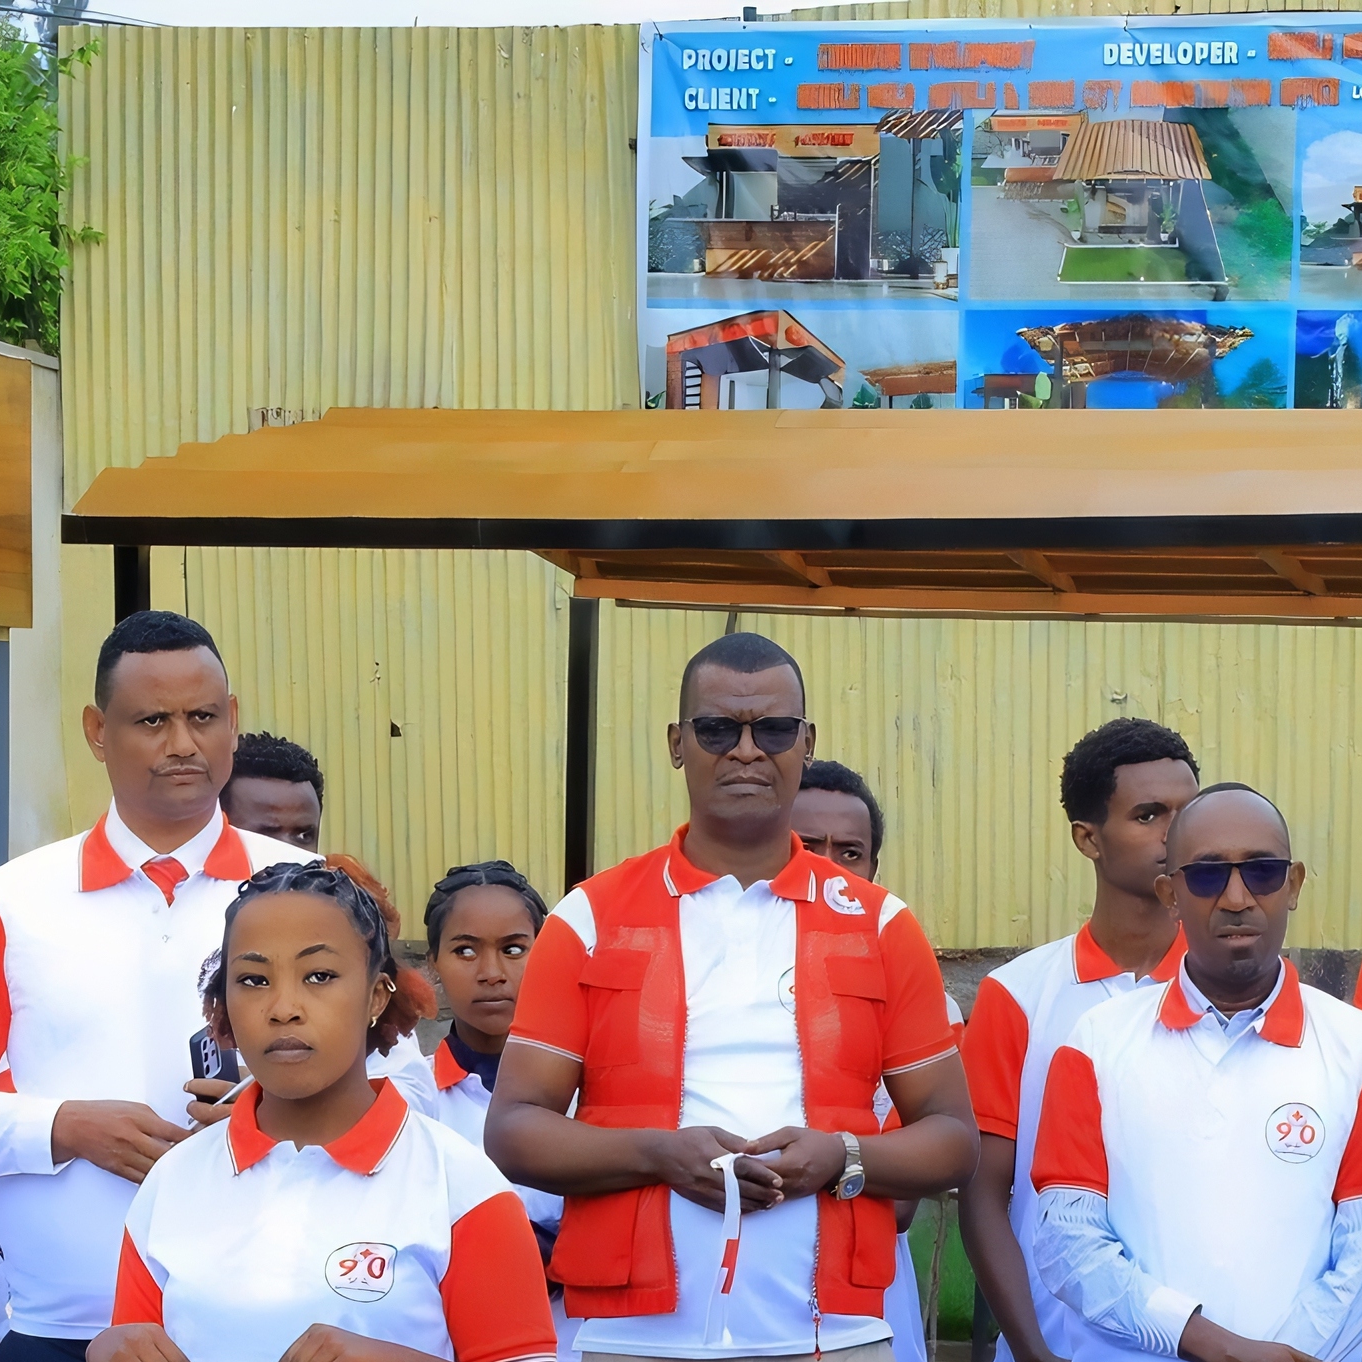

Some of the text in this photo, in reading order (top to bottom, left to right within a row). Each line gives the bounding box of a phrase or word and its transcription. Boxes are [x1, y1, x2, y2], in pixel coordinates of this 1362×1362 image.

[683, 48, 776, 70] PROJECT
[1103, 42, 1237, 65] DEVELOPER
[685, 87, 759, 110] CLIENT
